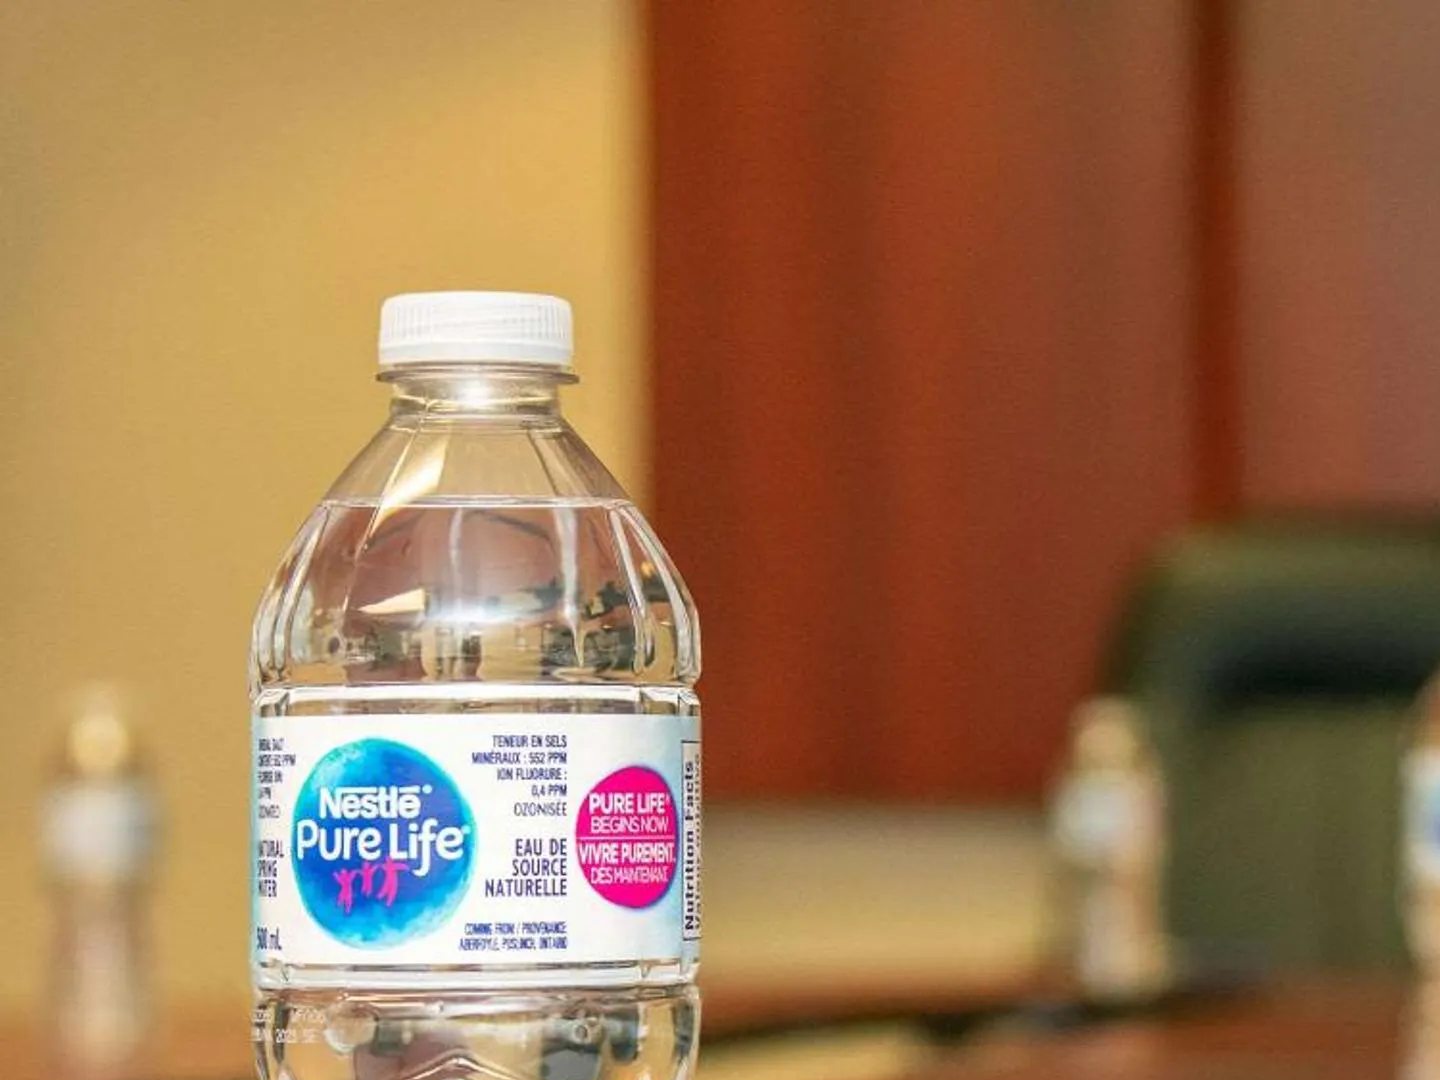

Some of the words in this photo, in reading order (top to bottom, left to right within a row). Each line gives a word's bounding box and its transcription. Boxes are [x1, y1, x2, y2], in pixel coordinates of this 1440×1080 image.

[493, 735, 528, 748] TENEUR
[531, 735, 543, 748] EN
[545, 735, 567, 748] SELS
[548, 752, 567, 764] PPM
[497, 768, 513, 780] ION
[548, 785, 567, 796] PPM
[589, 792, 634, 814] PURE
[637, 792, 665, 814] LIFE
[591, 816, 640, 833] BEGINS
[641, 816, 669, 833] NOW
[297, 819, 382, 860] Pure
[389, 818, 464, 877] Life
[516, 839, 542, 856] EAU
[550, 839, 567, 856] DE
[580, 842, 619, 864] VIVRE
[512, 859, 567, 876] SOURCE
[485, 879, 567, 897] NATURELLE
[685, 830, 694, 930] Nutrition
